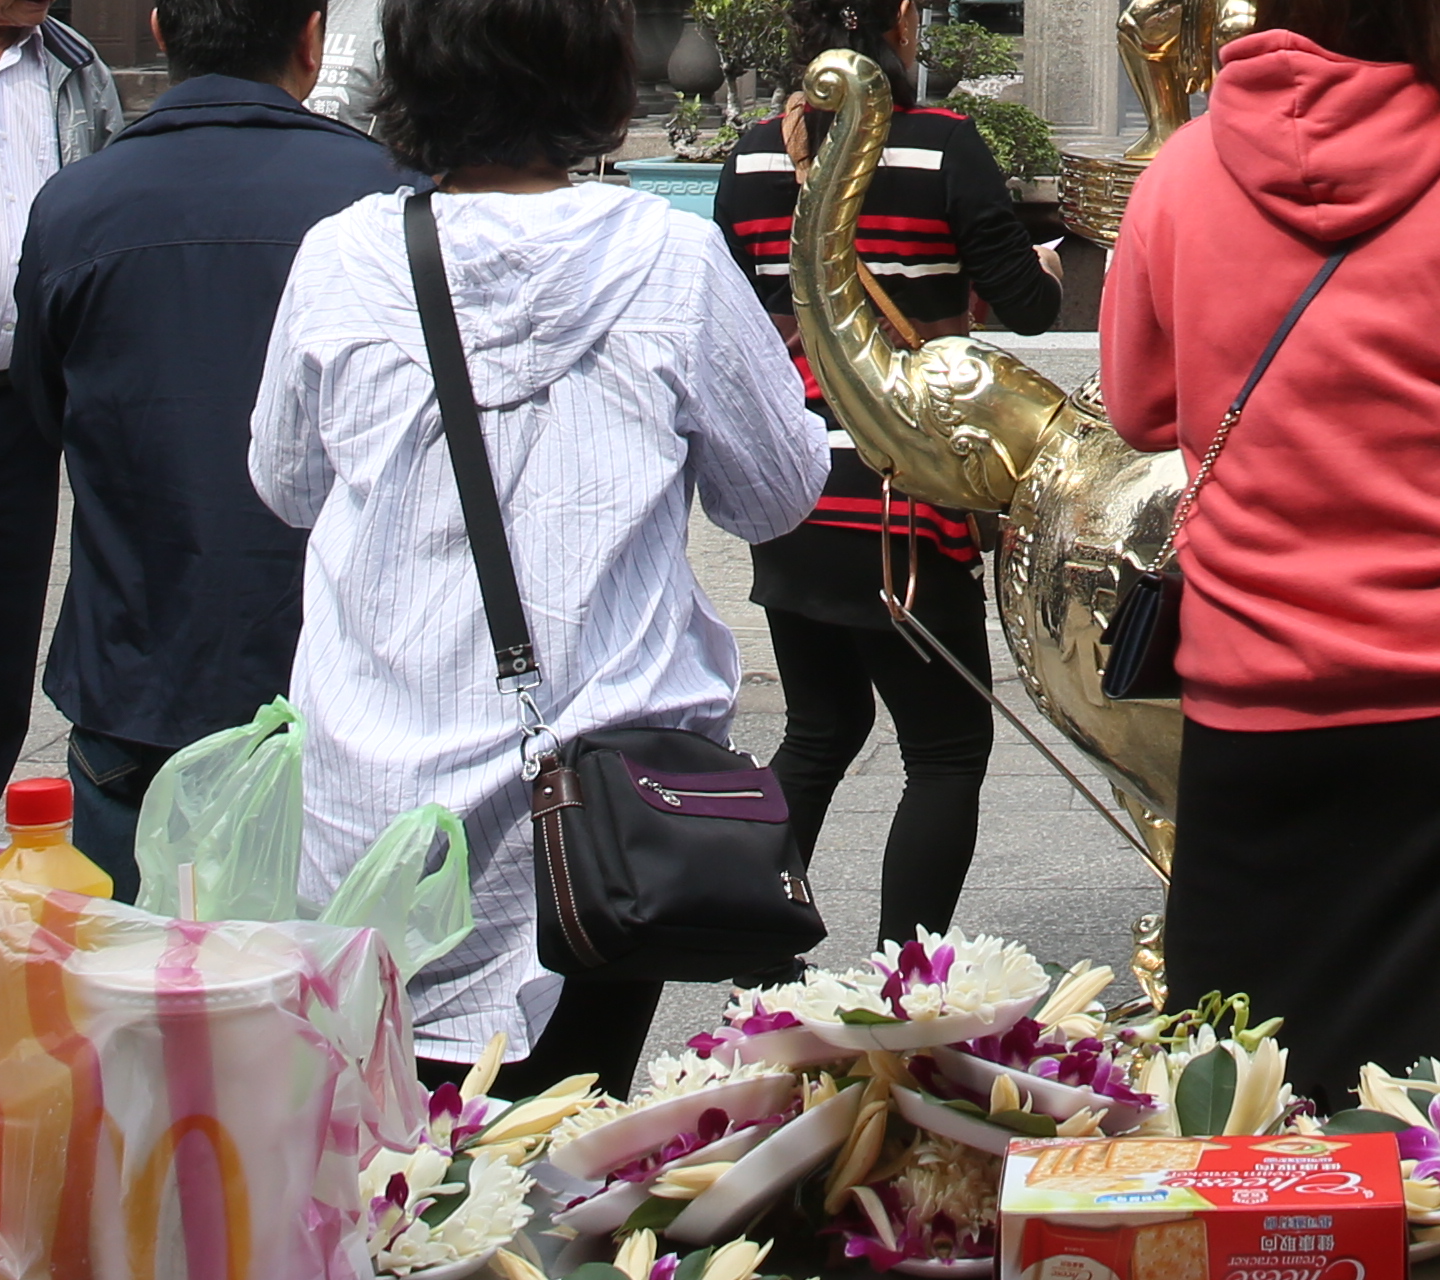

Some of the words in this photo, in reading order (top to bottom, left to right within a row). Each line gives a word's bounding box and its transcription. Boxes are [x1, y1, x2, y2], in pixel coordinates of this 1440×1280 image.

[1160, 1170, 1366, 1196] Cheese
[1260, 1234, 1336, 1252] 健康取向
[1226, 1255, 1278, 1268] cracker
[1282, 1255, 1328, 1267] Cream
